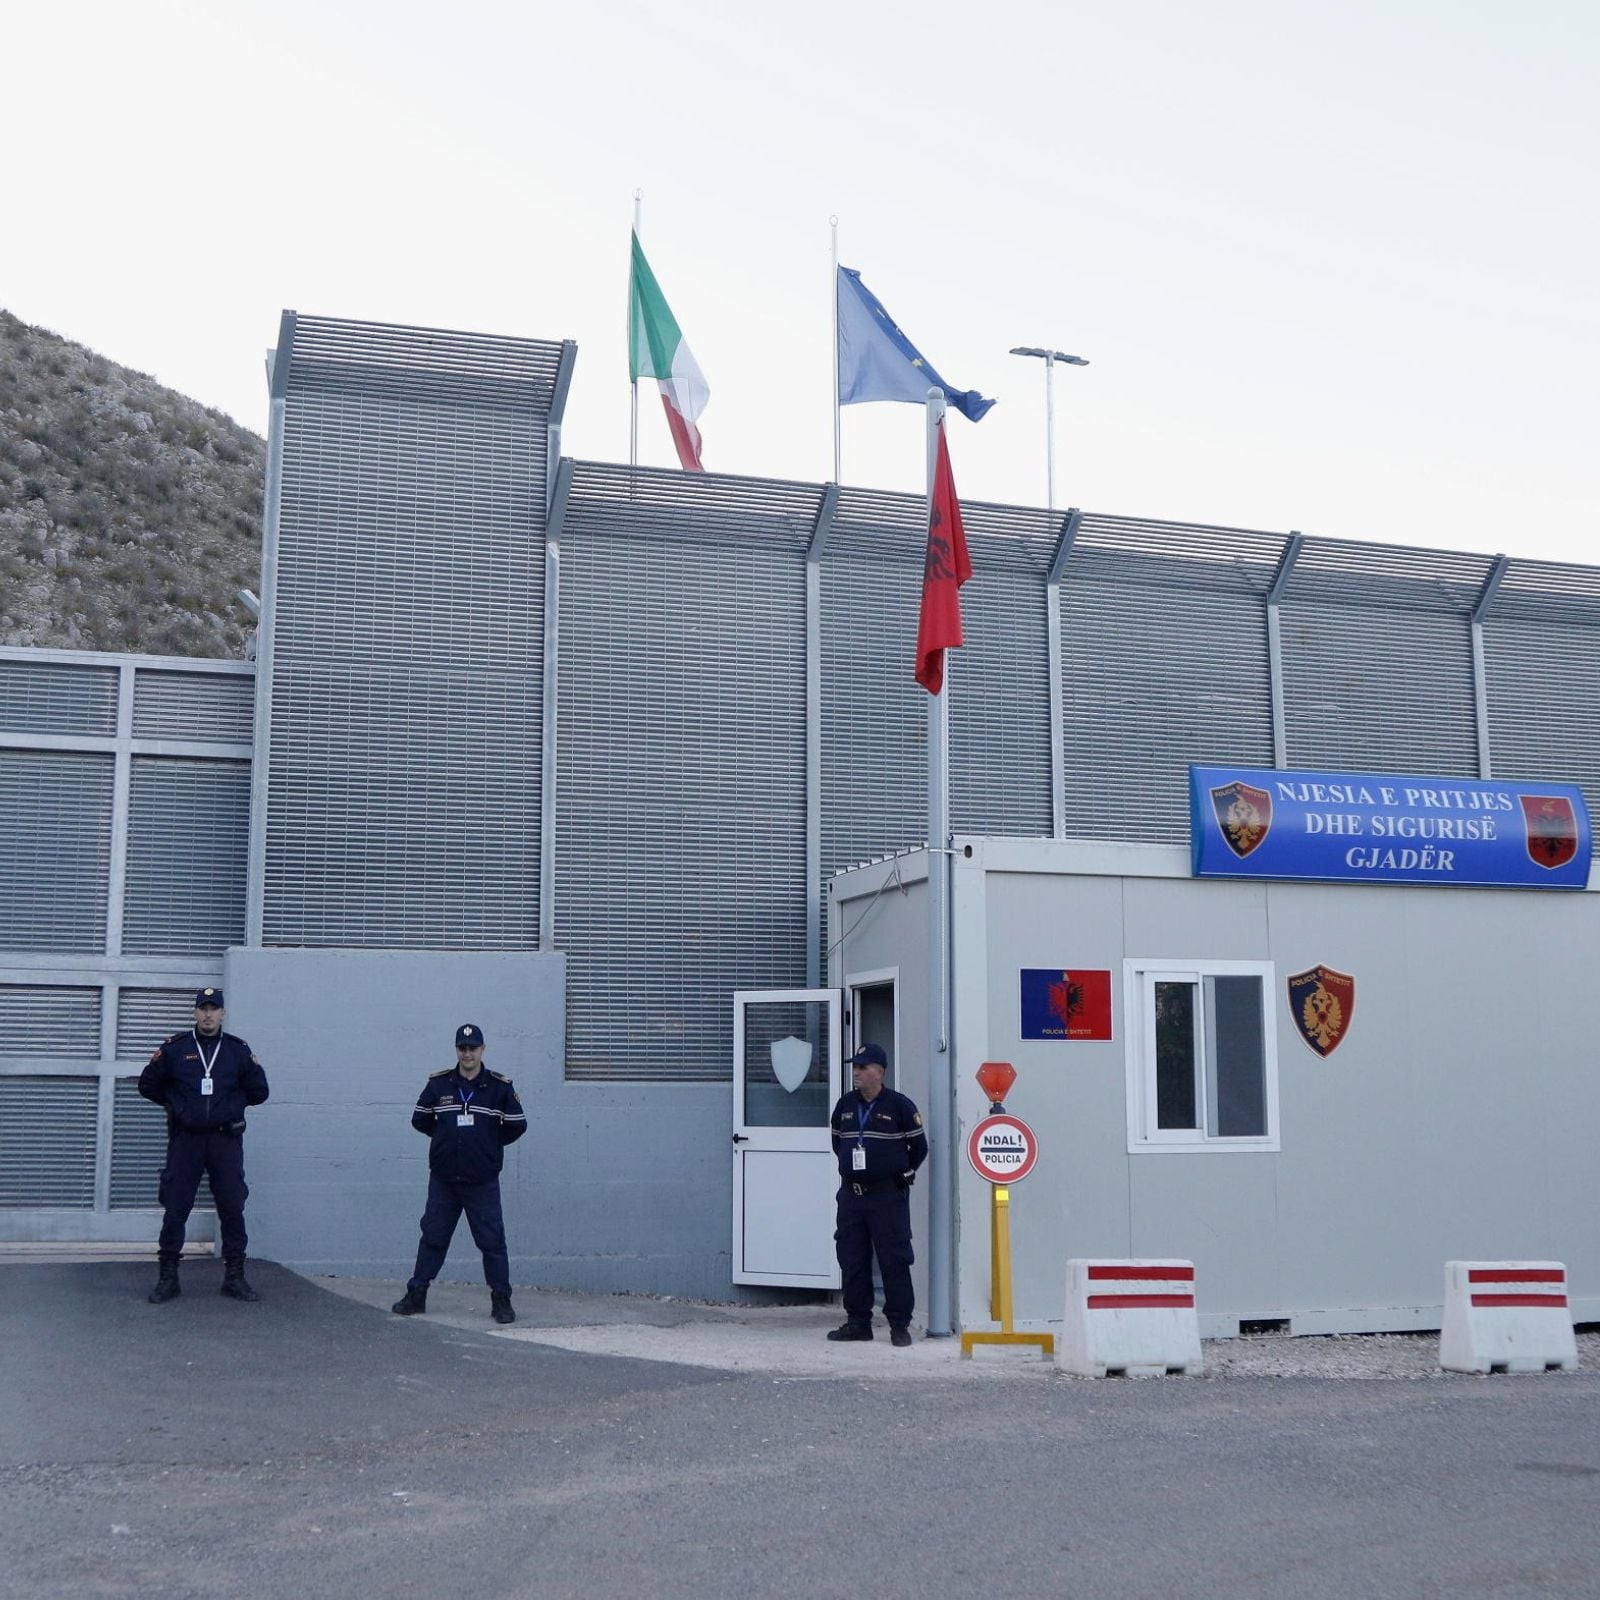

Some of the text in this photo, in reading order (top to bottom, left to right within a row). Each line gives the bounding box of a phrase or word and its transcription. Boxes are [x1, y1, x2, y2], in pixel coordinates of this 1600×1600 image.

[1275, 782, 1514, 812] NJESIA E PRITJES
[1305, 813, 1497, 841] DHE SIGURISË
[1346, 845, 1455, 871] GJADËR
[1291, 973, 1319, 987] POLICIA
[984, 1134, 1022, 1147] NDAL!
[985, 1154, 1021, 1164] POLICIA
